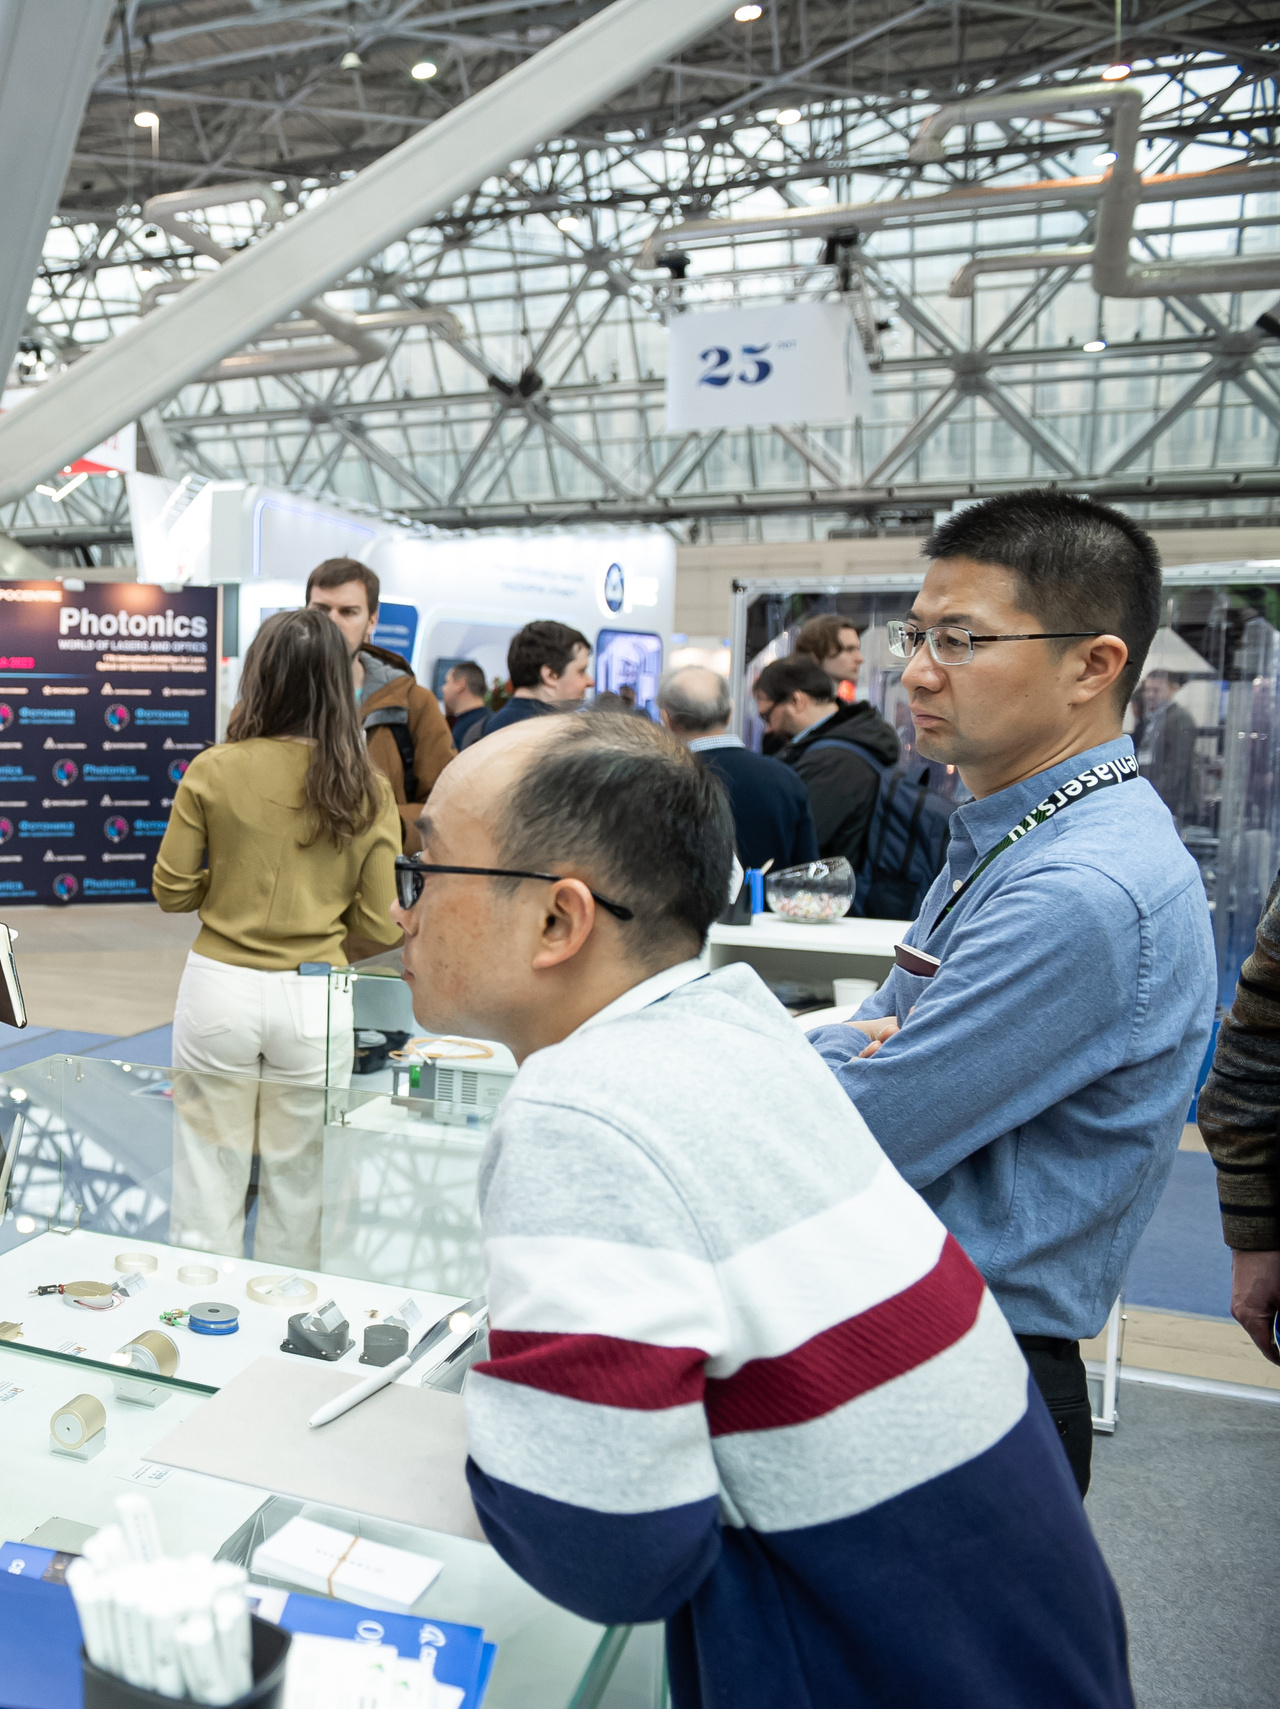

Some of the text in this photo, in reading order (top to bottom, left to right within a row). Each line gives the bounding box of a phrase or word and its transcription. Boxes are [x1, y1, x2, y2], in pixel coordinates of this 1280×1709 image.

[698, 341, 774, 388] 25
[59, 607, 208, 638] Photonics
[58, 639, 208, 653] WORLD OF LASERS AND OPTICS
